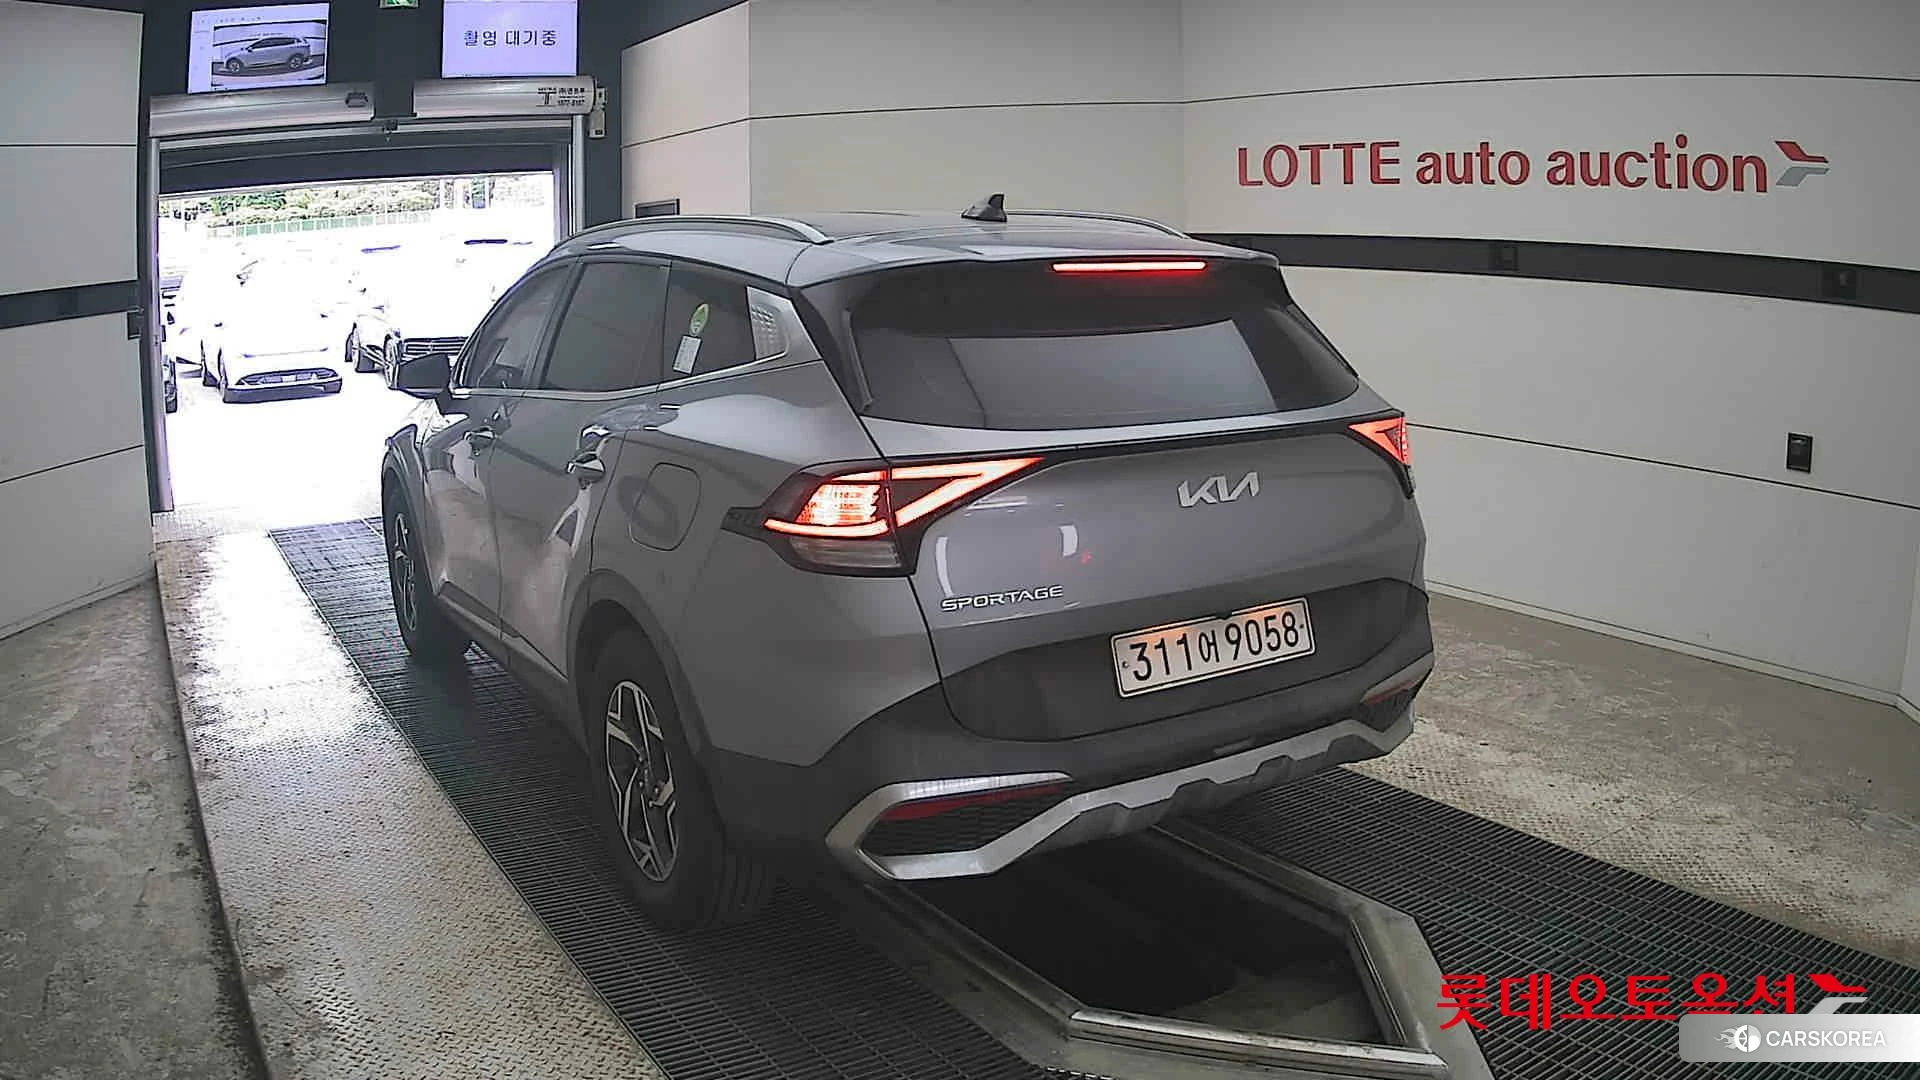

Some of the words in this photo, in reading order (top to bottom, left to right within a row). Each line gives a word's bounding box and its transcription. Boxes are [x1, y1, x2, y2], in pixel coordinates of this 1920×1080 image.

[463, 30, 497, 47] 촬영
[505, 30, 557, 46] 대기중
[1237, 140, 1401, 187] LOTTE
[1415, 141, 1531, 186] auto
[1545, 134, 1768, 194] auction
[1176, 471, 1261, 508] KIA
[941, 584, 1064, 612] SPORTAGE
